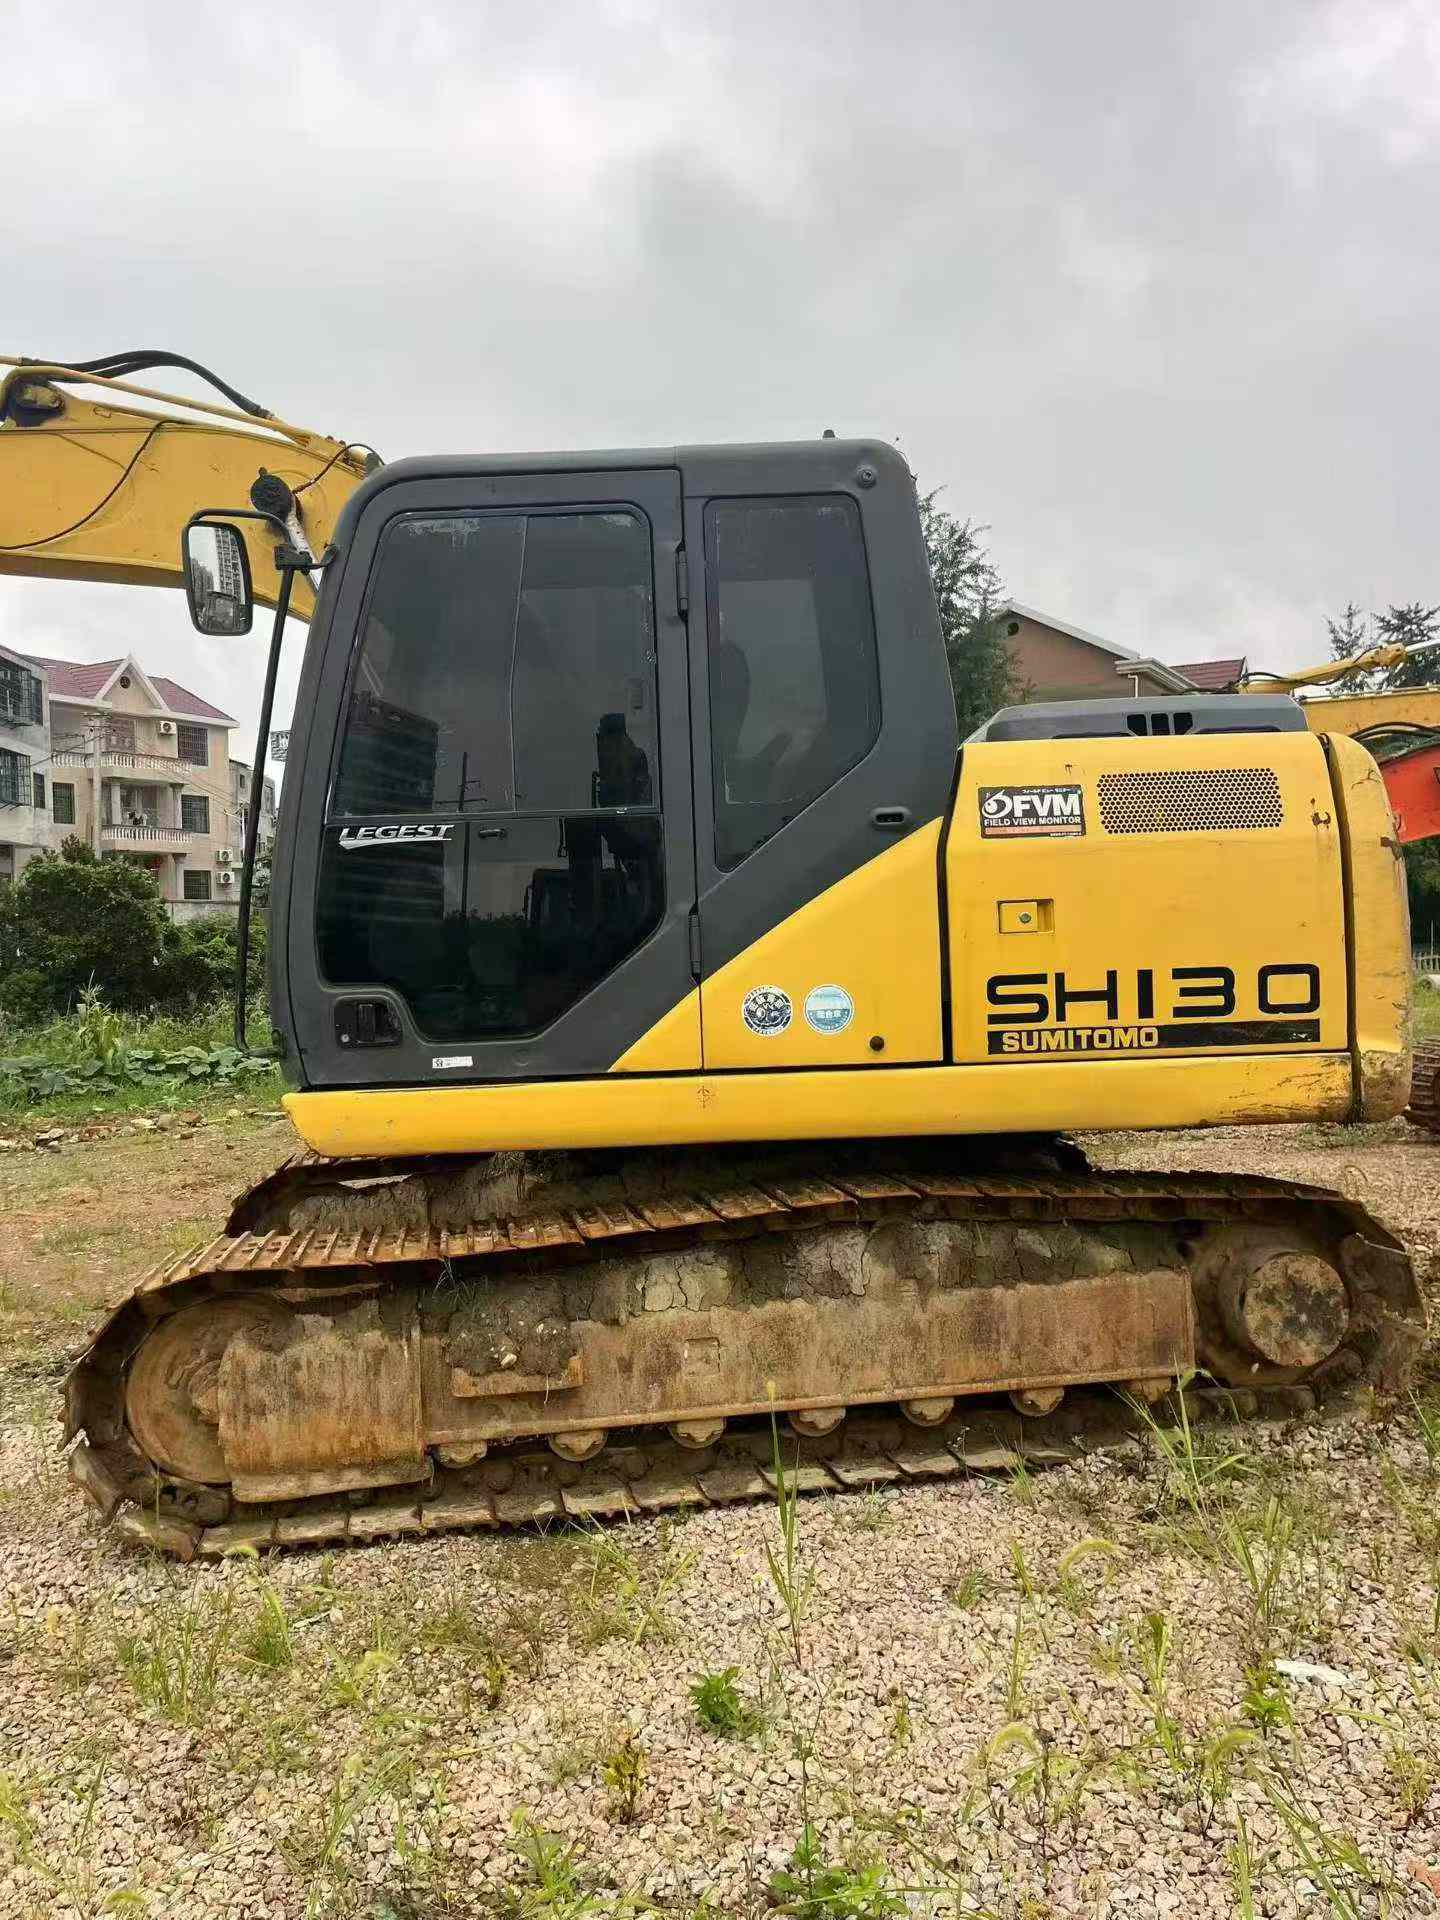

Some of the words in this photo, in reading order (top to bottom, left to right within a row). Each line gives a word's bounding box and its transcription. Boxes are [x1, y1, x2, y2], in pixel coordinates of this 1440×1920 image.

[1012, 793, 1081, 817] FVM
[338, 824, 455, 841] LEGEST
[984, 817, 1011, 827] FIELD
[1012, 817, 1037, 826] VIEW
[1039, 815, 1082, 825] MONITOR
[986, 963, 1320, 1025] SH130
[1002, 1027, 1159, 1052] SUMITOMO
